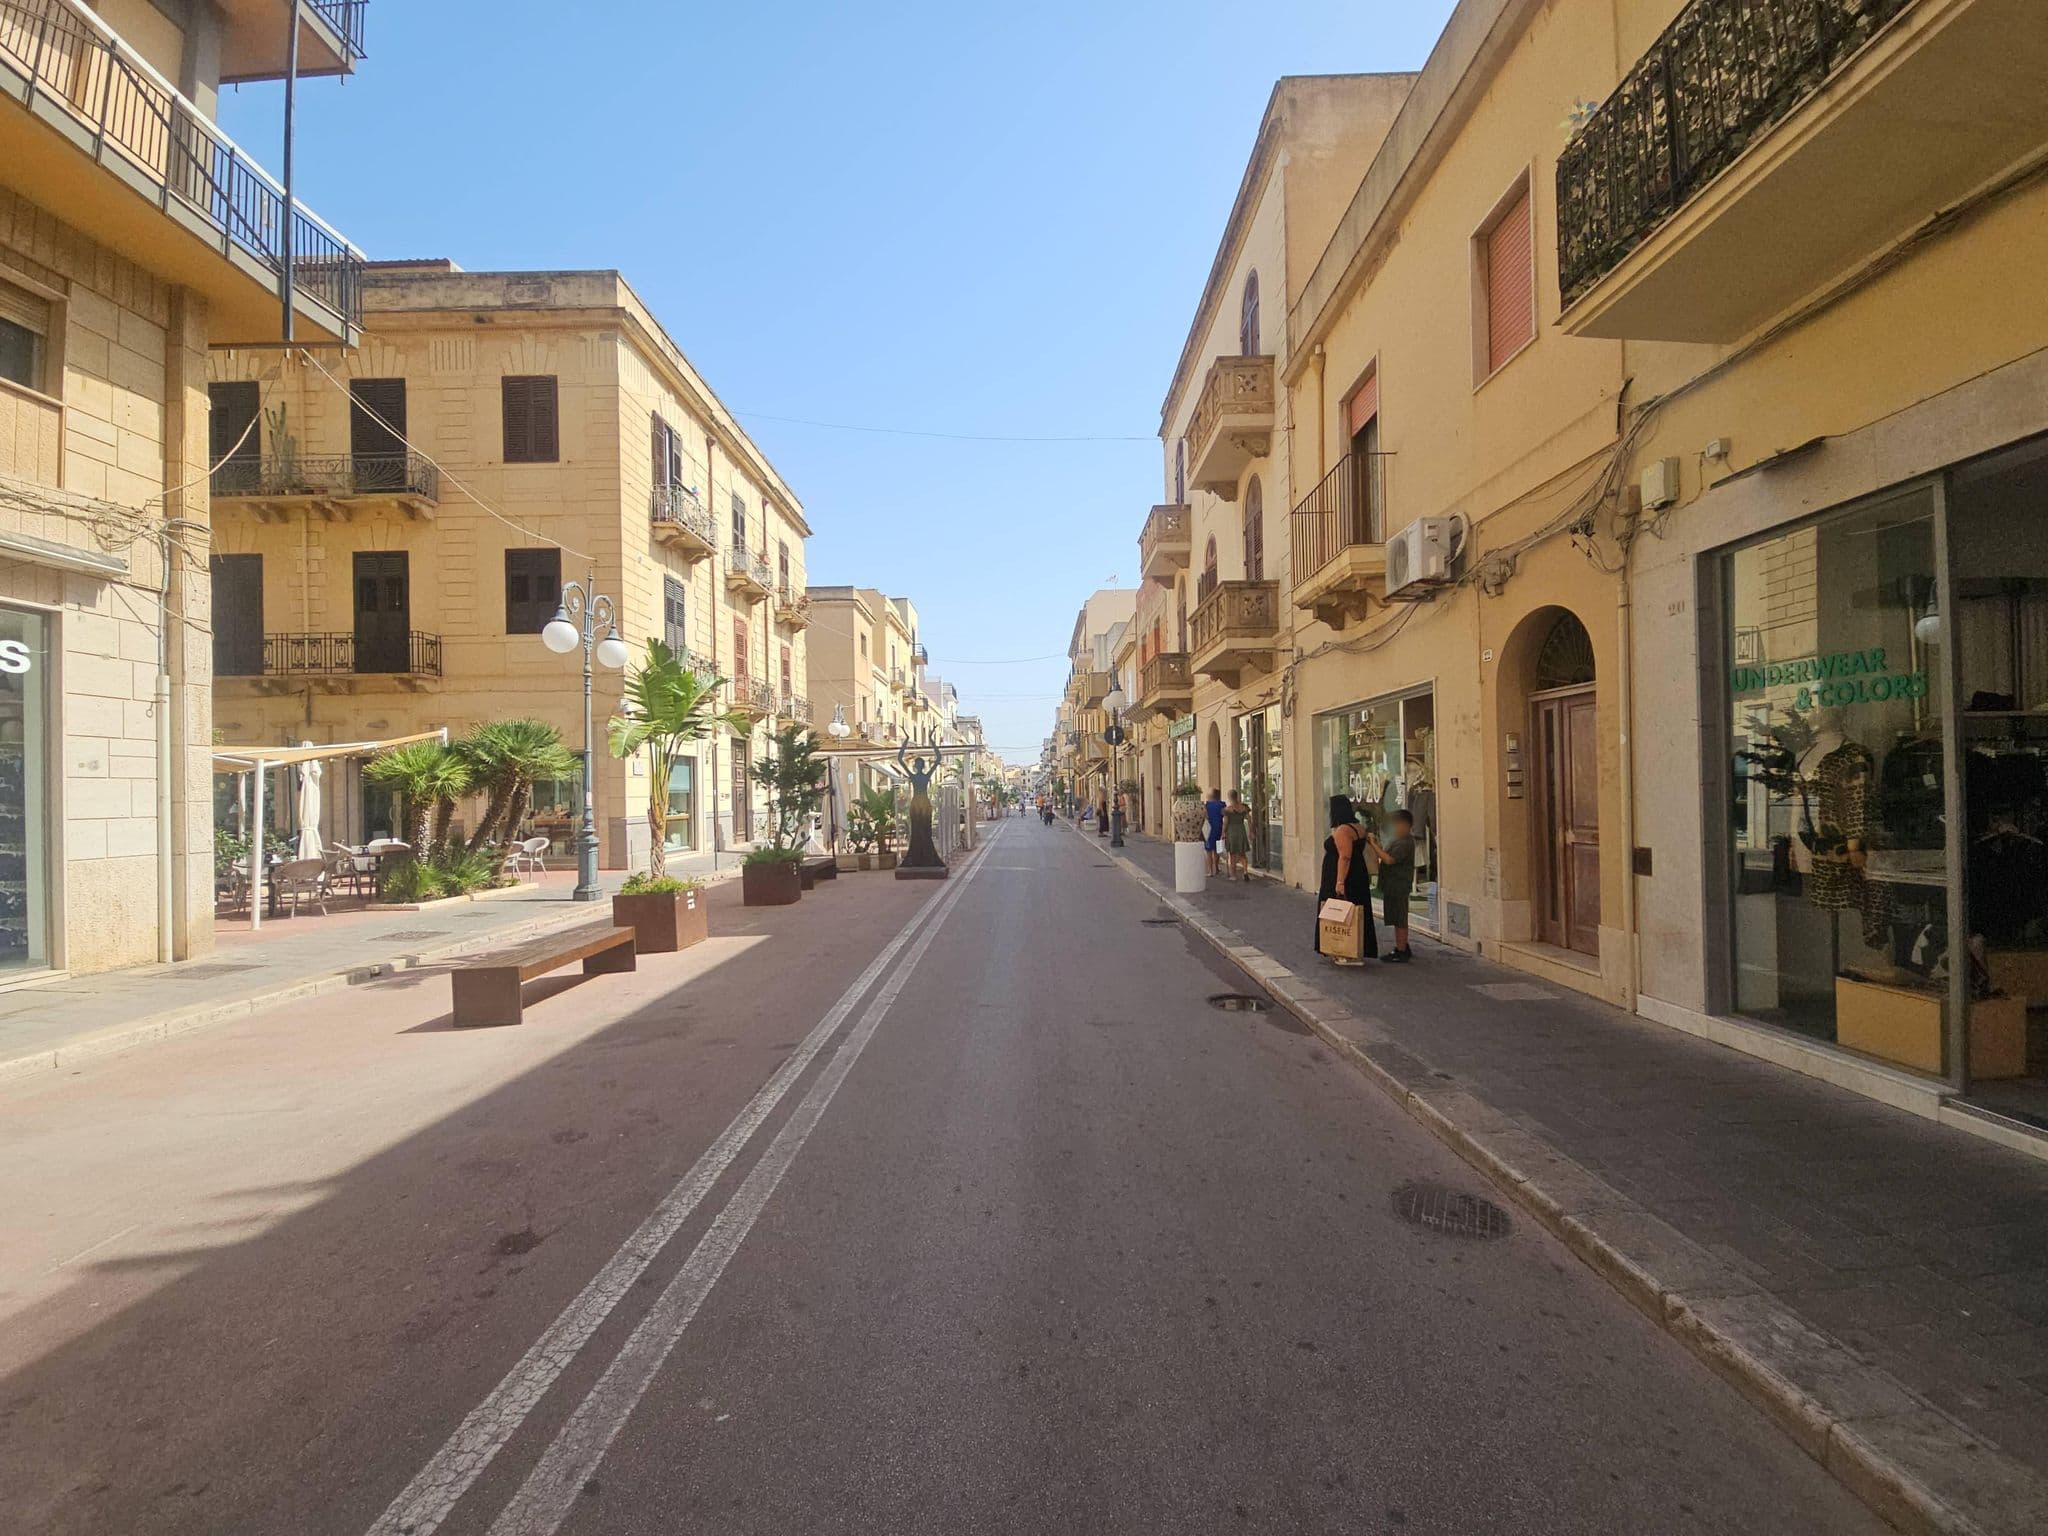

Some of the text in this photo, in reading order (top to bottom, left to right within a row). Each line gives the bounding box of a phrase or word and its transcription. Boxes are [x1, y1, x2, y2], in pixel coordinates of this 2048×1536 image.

[1730, 648, 1887, 692] UNDERWEAR
[1795, 672, 1928, 711] & COLORS
